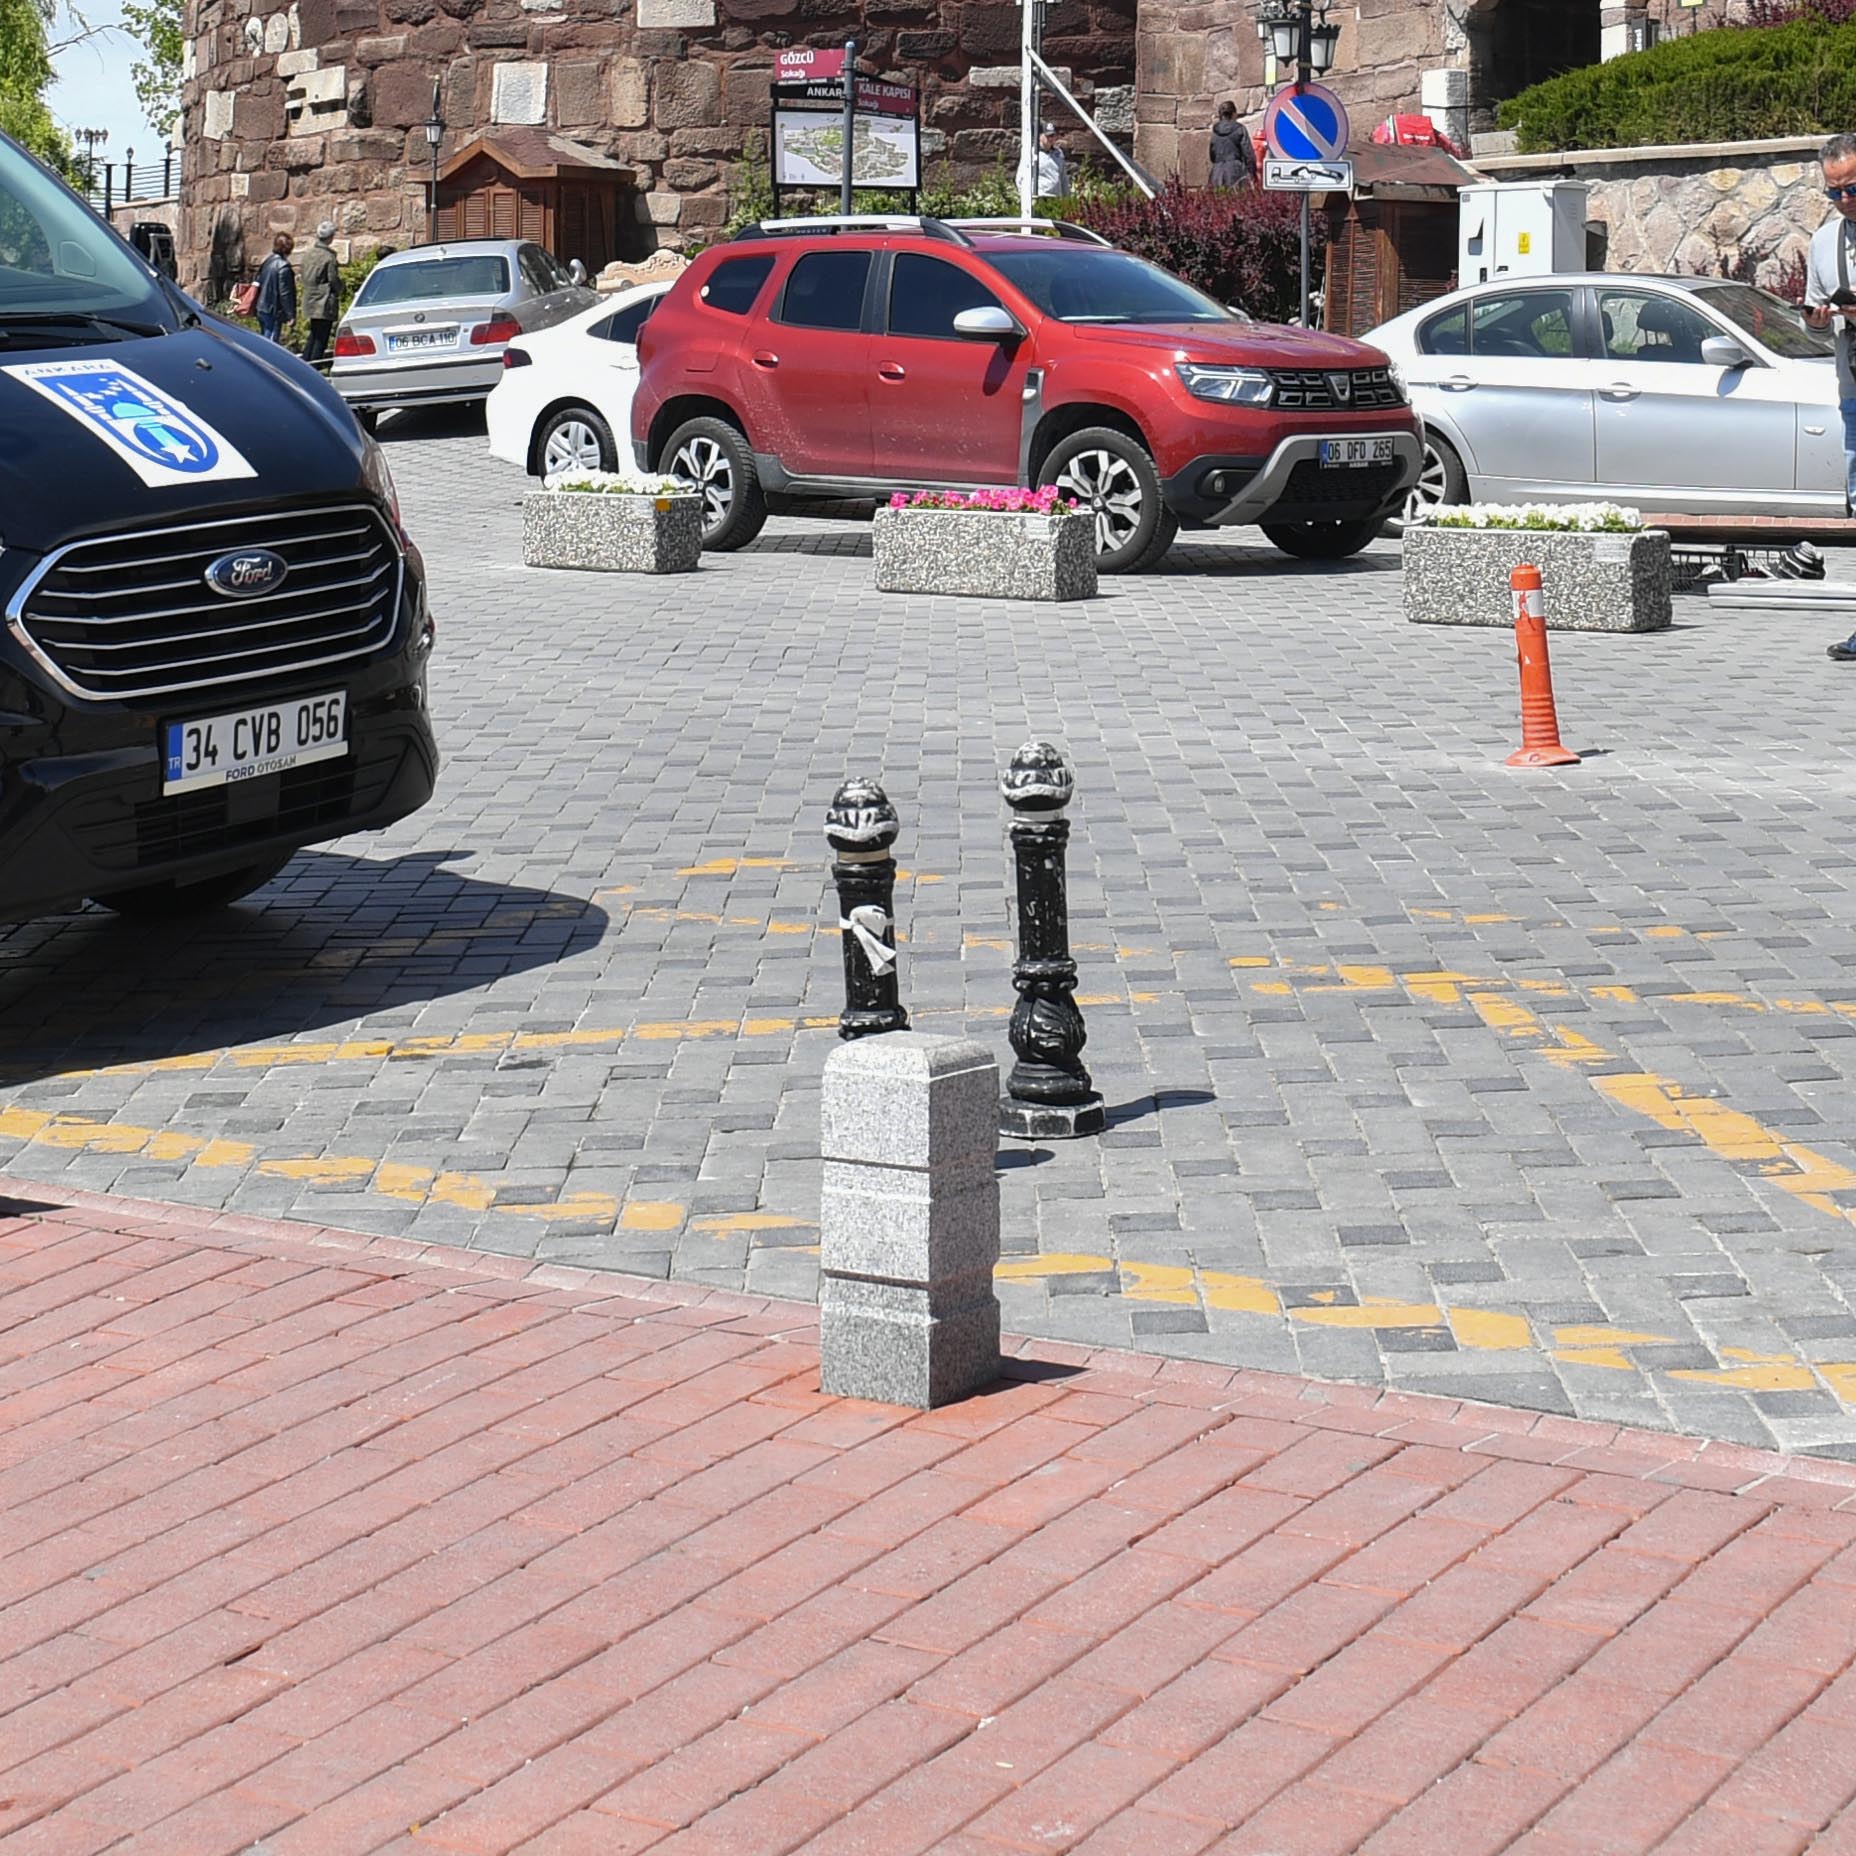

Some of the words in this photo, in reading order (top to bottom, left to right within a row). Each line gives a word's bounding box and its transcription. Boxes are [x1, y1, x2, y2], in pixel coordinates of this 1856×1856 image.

[780, 50, 815, 65] GÖZCÜ
[806, 86, 845, 97] ANKAR
[858, 83, 881, 96] KALE
[882, 85, 911, 100] KAPISI
[396, 337, 409, 348] 06
[412, 333, 436, 346] BCA
[1328, 443, 1341, 460] 06
[1373, 439, 1391, 458] 265
[231, 556, 273, 587] Ford
[186, 724, 218, 771] 34
[233, 712, 281, 761] CVB
[297, 698, 341, 746] 056
[168, 756, 181, 770] TR
[225, 765, 255, 781] FORD
